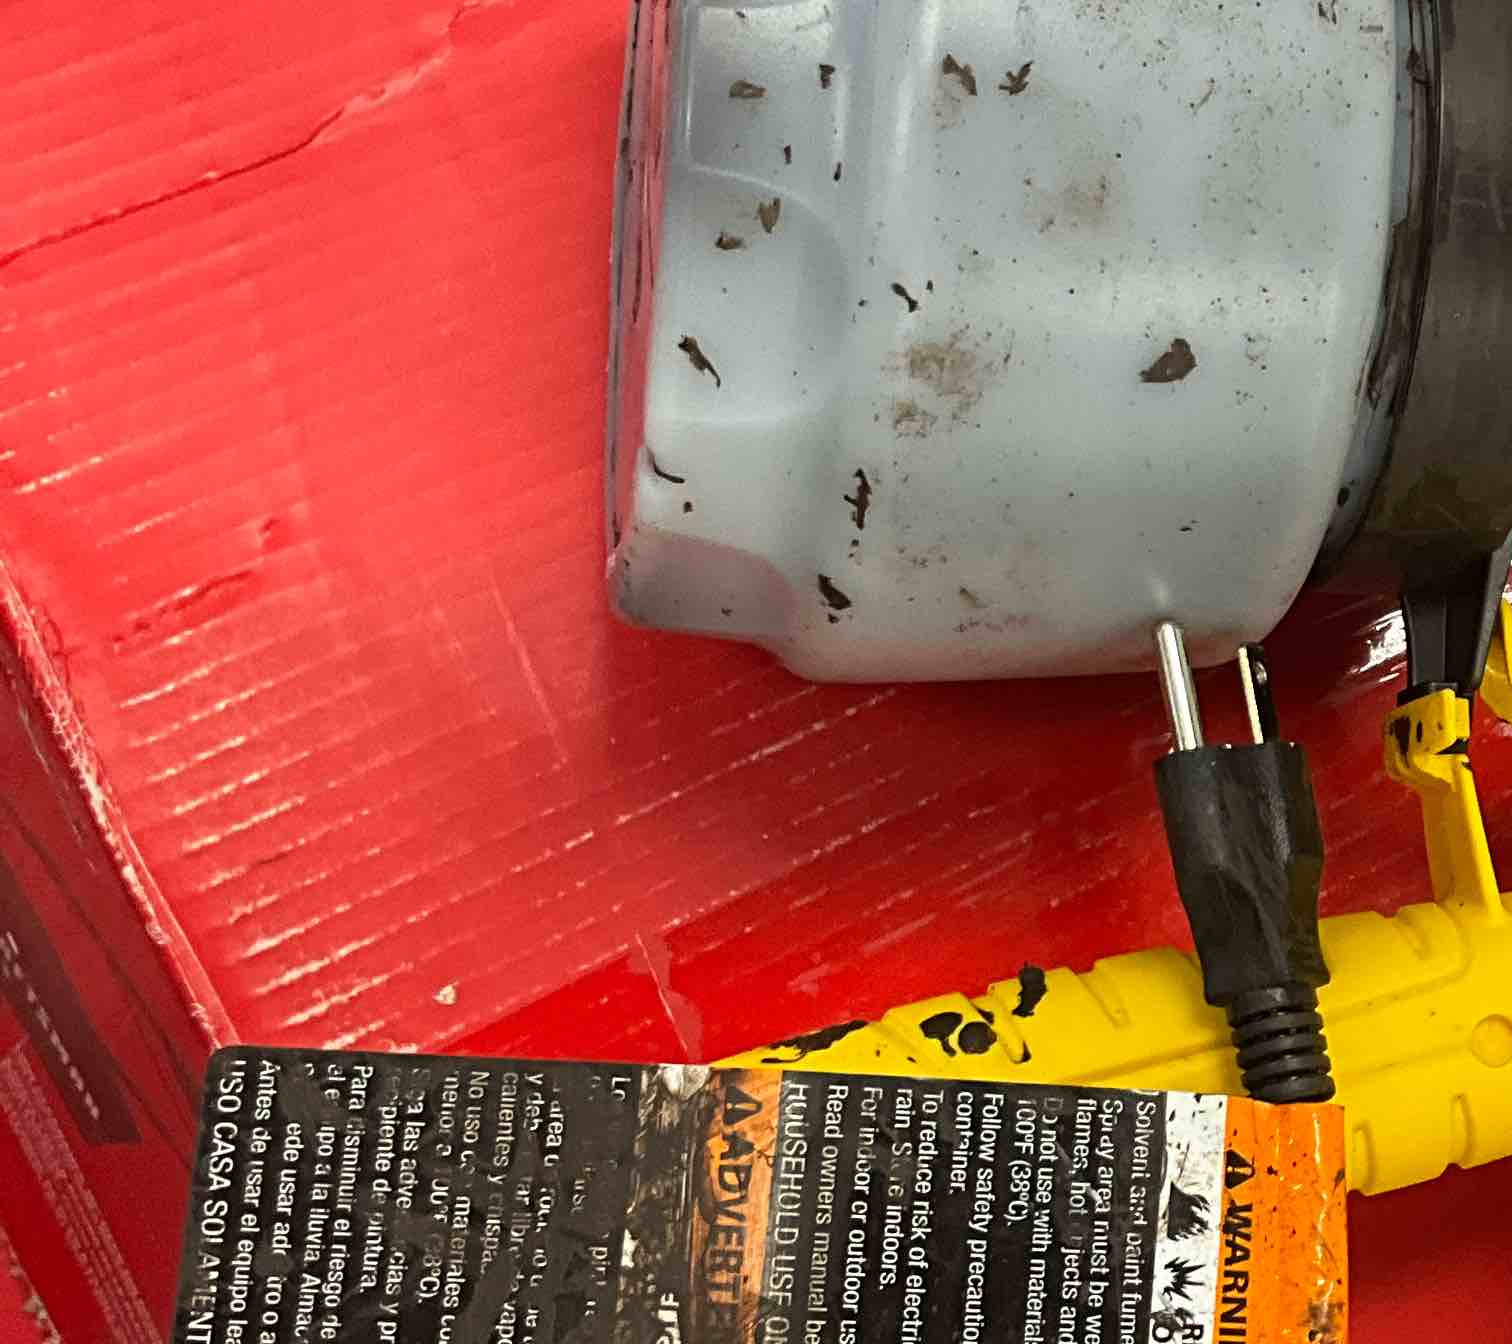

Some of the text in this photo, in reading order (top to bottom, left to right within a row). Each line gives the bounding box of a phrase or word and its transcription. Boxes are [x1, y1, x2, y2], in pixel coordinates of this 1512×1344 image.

[347, 1065, 372, 1110] Para
[469, 1071, 491, 1099] No
[525, 1073, 545, 1084] y
[463, 1106, 483, 1142] uso
[823, 1084, 847, 1138] Read
[860, 1087, 882, 1120] For
[921, 1090, 943, 1114] To
[249, 1127, 272, 1152] de
[402, 1121, 425, 1152] las
[486, 1072, 522, 1184] calientes y
[949, 1091, 975, 1195] container.
[977, 1093, 1002, 1161] Follow
[1039, 1129, 1060, 1161] not
[1067, 1098, 1096, 1175] flames,
[1130, 1101, 1156, 1179] Solvent
[205, 1121, 237, 1191] CASA
[314, 1163, 331, 1176] a
[774, 1083, 809, 1244] HOUSEHOLD
[853, 1127, 879, 1194] indoor
[914, 1120, 940, 1193] reduce
[242, 1160, 263, 1206] usar
[311, 1183, 333, 1200] la
[814, 1145, 837, 1224] owners
[967, 1167, 996, 1232] safety
[1036, 1167, 1054, 1203] use
[1067, 1182, 1089, 1215] hot
[1094, 1166, 1113, 1213] area
[239, 1214, 261, 1232] el
[332, 1218, 353, 1237] el
[910, 1200, 933, 1240] risk
[1031, 1210, 1054, 1252] with
[262, 1169, 297, 1325] usar o
[879, 1204, 905, 1291] indoors.
[907, 1247, 928, 1269] of
[1089, 1220, 1111, 1274] must
[1117, 1232, 1144, 1286] paint
[224, 1239, 256, 1313] equipo
[319, 1243, 349, 1308] riesgo
[806, 1232, 833, 1311] manual
[842, 1230, 869, 1313] outdoor
[1087, 1281, 1108, 1307] be
[319, 1315, 341, 1339] de
[379, 1303, 399, 1314] y
